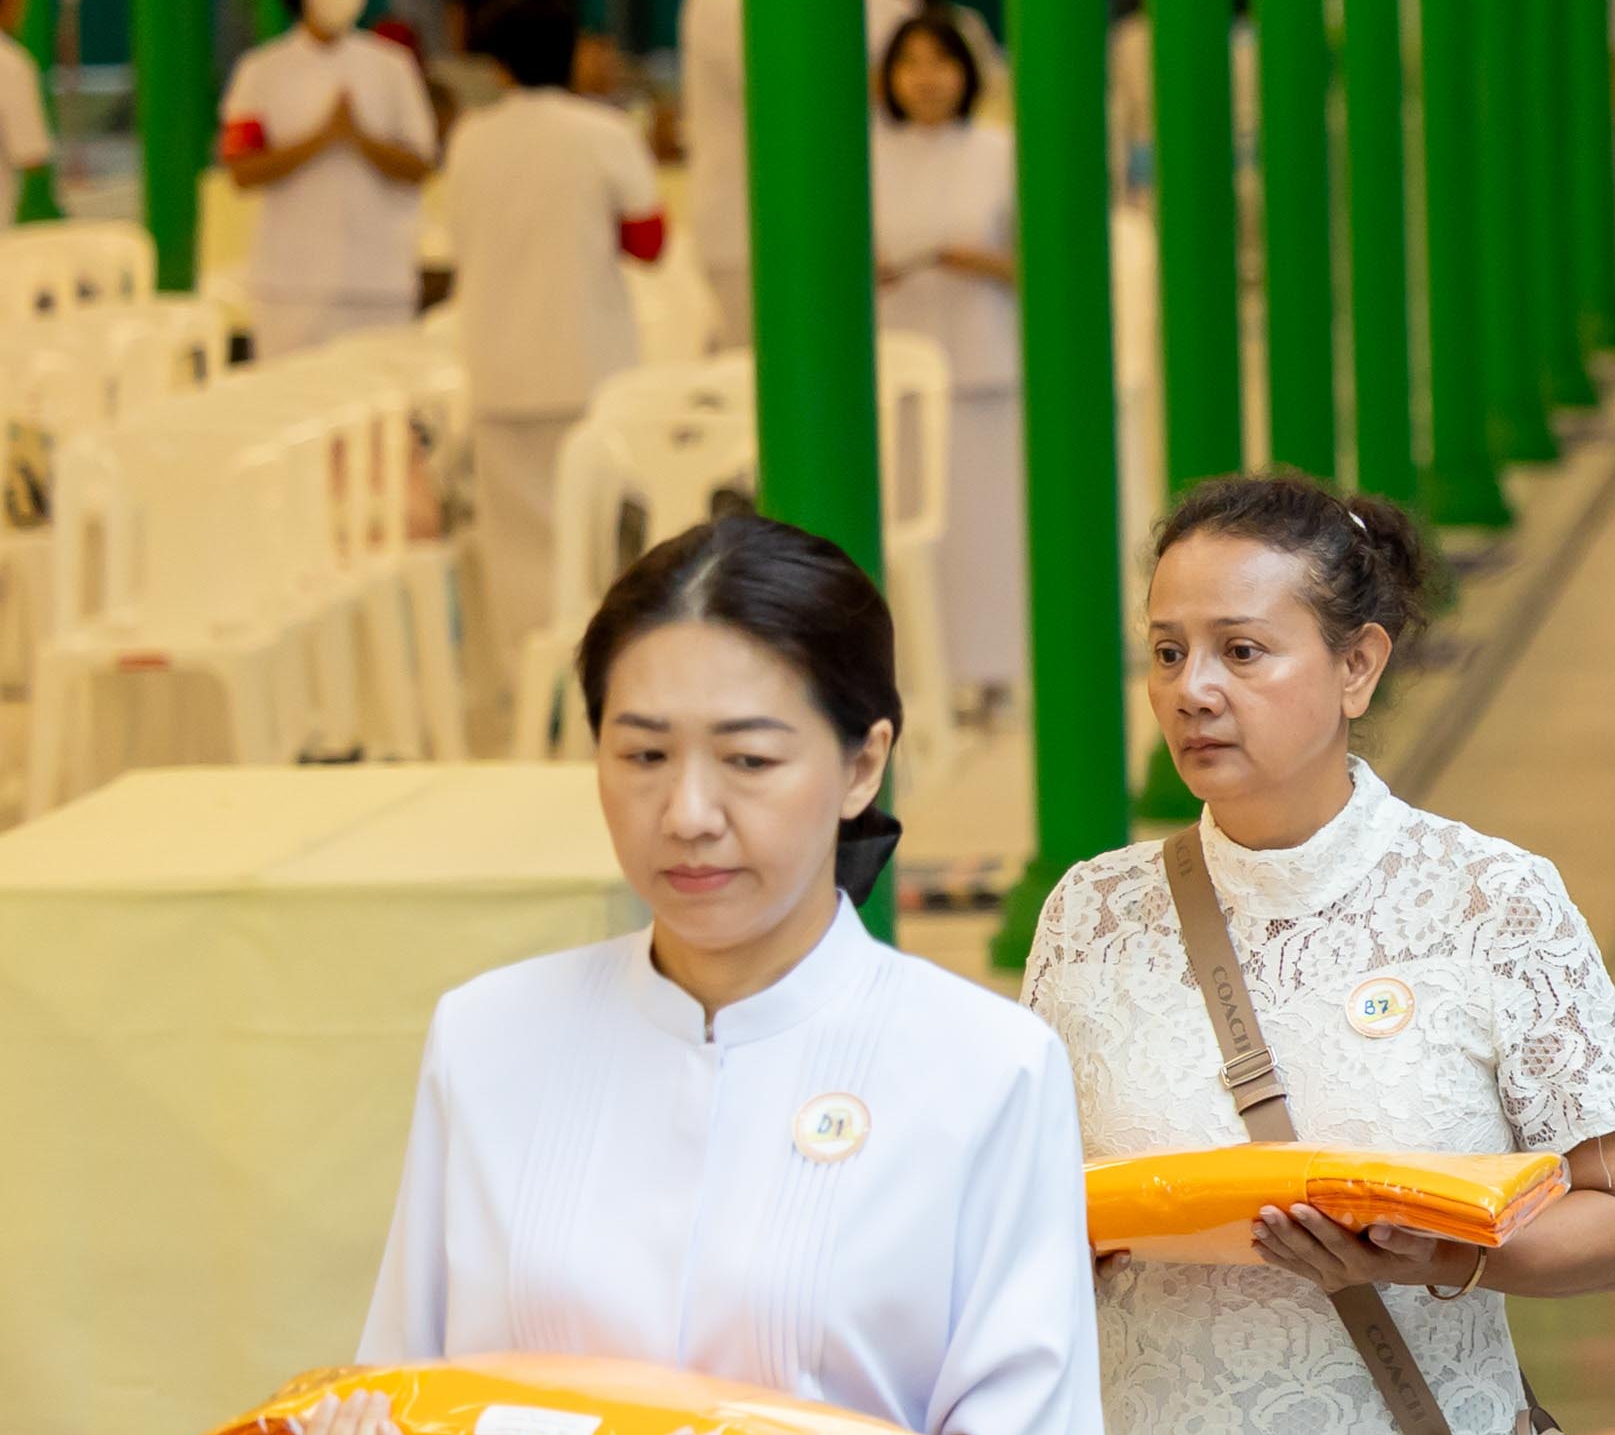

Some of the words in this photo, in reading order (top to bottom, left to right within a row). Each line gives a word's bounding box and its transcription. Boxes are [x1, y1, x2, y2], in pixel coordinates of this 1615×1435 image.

[1212, 965, 1251, 1054] COACH
[1364, 999, 1389, 1015] B7
[1366, 1324, 1425, 1422] COACH
